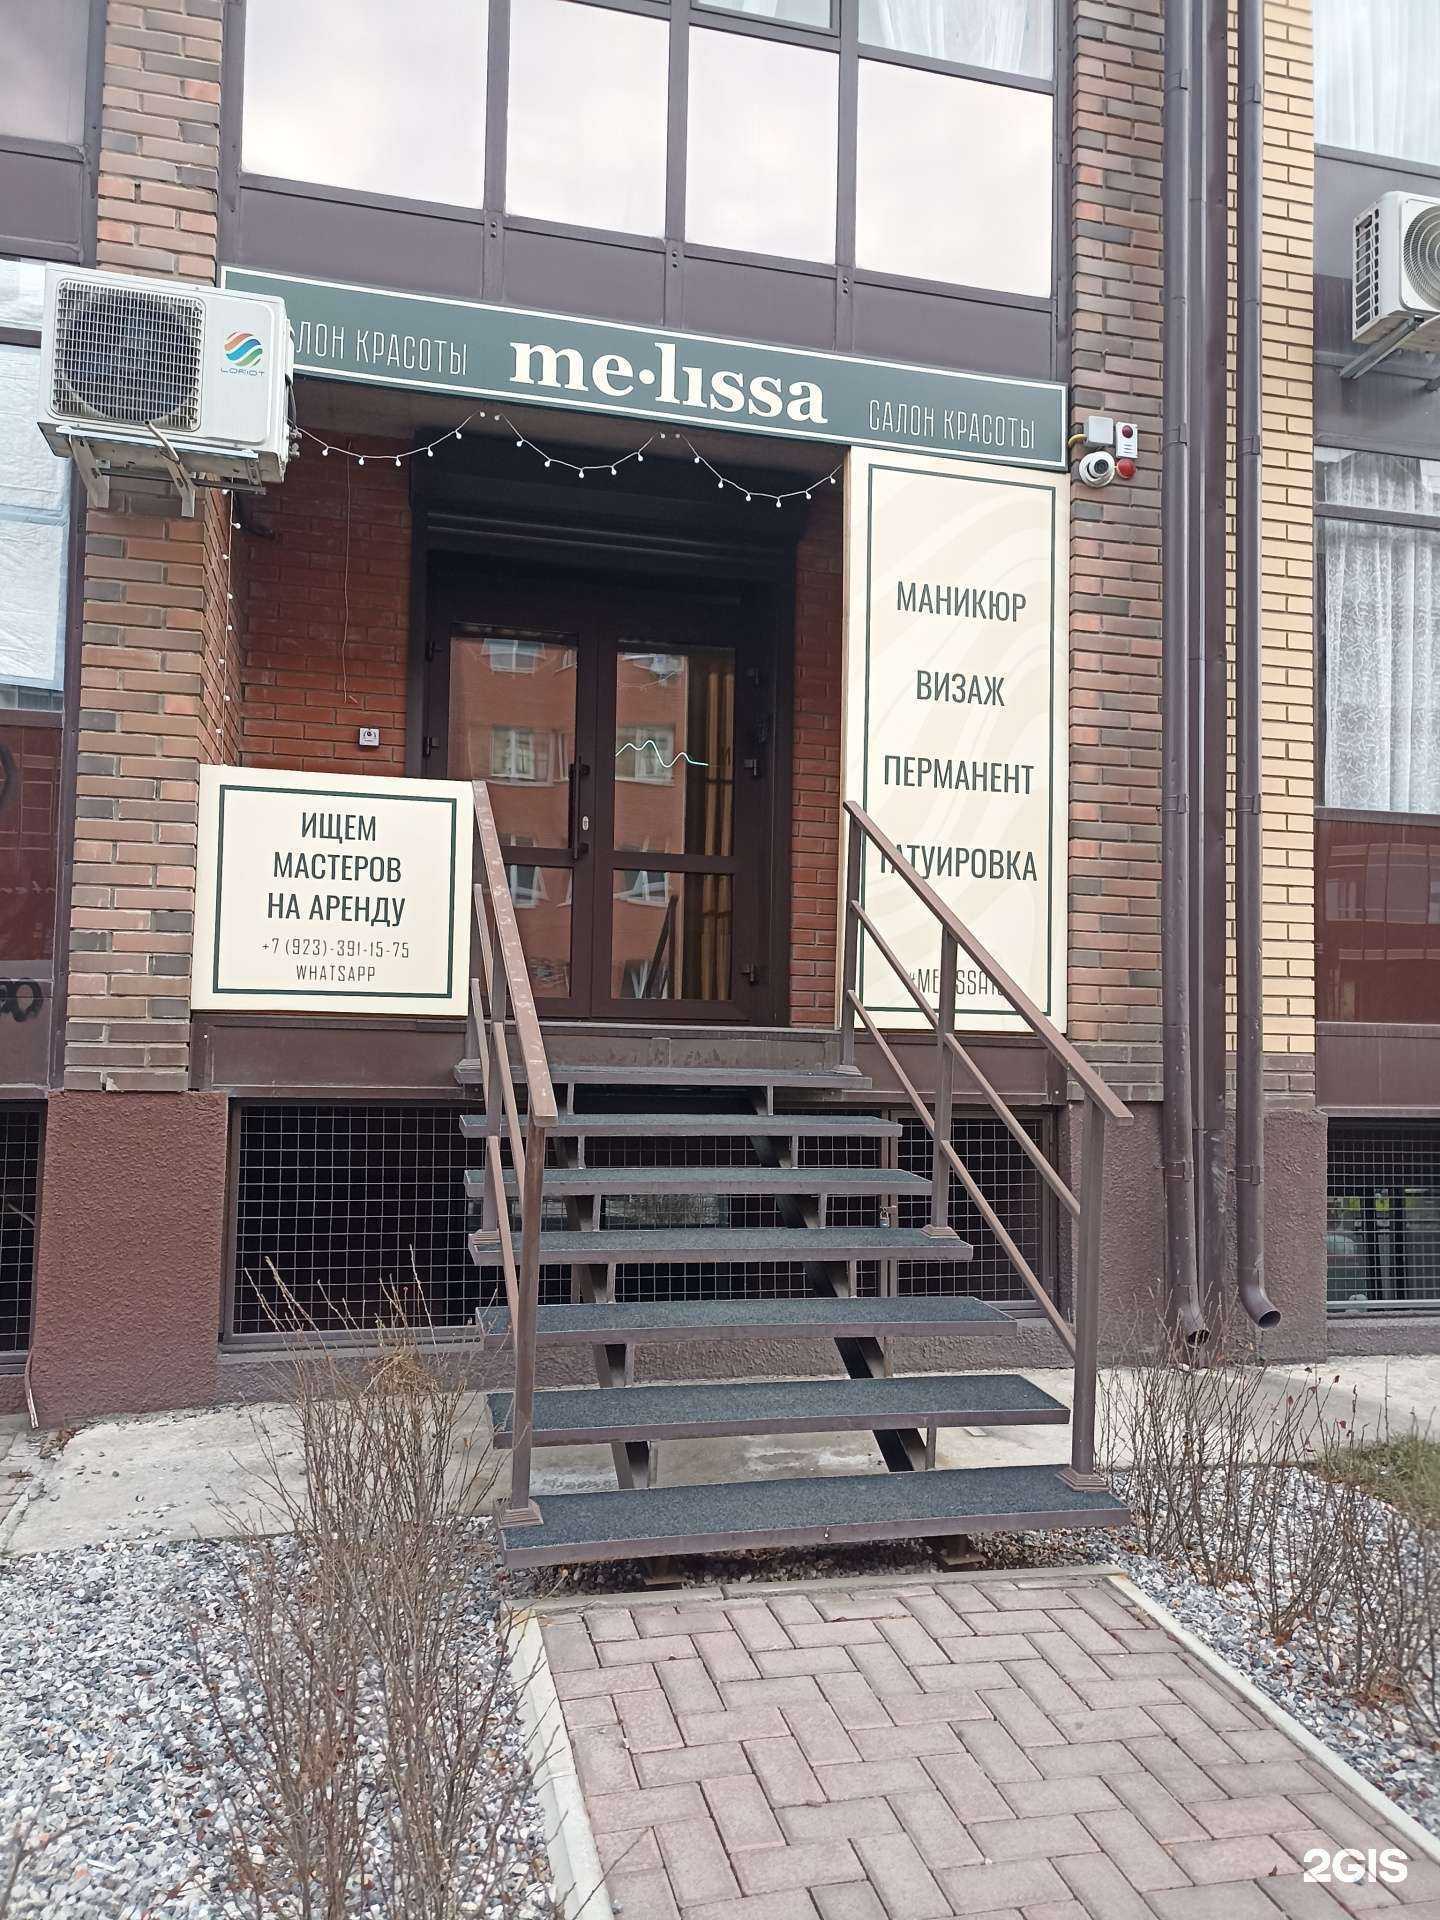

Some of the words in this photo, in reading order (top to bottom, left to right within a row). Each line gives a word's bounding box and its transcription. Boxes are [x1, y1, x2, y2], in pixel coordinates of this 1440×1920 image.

[296, 321, 345, 360] ЛОН
[356, 329, 467, 376] КРАСОТЫ
[220, 368, 265, 376] LORIOT
[869, 399, 934, 438] САЛОН
[943, 409, 1036, 449] КРАСОТЫ
[897, 580, 1026, 622] МАНИКЮР
[916, 669, 1005, 706] ВИЗАЖ
[884, 755, 1034, 795] ПЕРМАНЕНТ
[301, 812, 377, 844] ИЩЕМ
[273, 851, 402, 883] МАСТЕРОВ
[267, 892, 301, 920] НА
[309, 894, 406, 928] АРЕНДУ
[262, 937, 279, 954] +7
[296, 965, 375, 982] WHATSAPP
